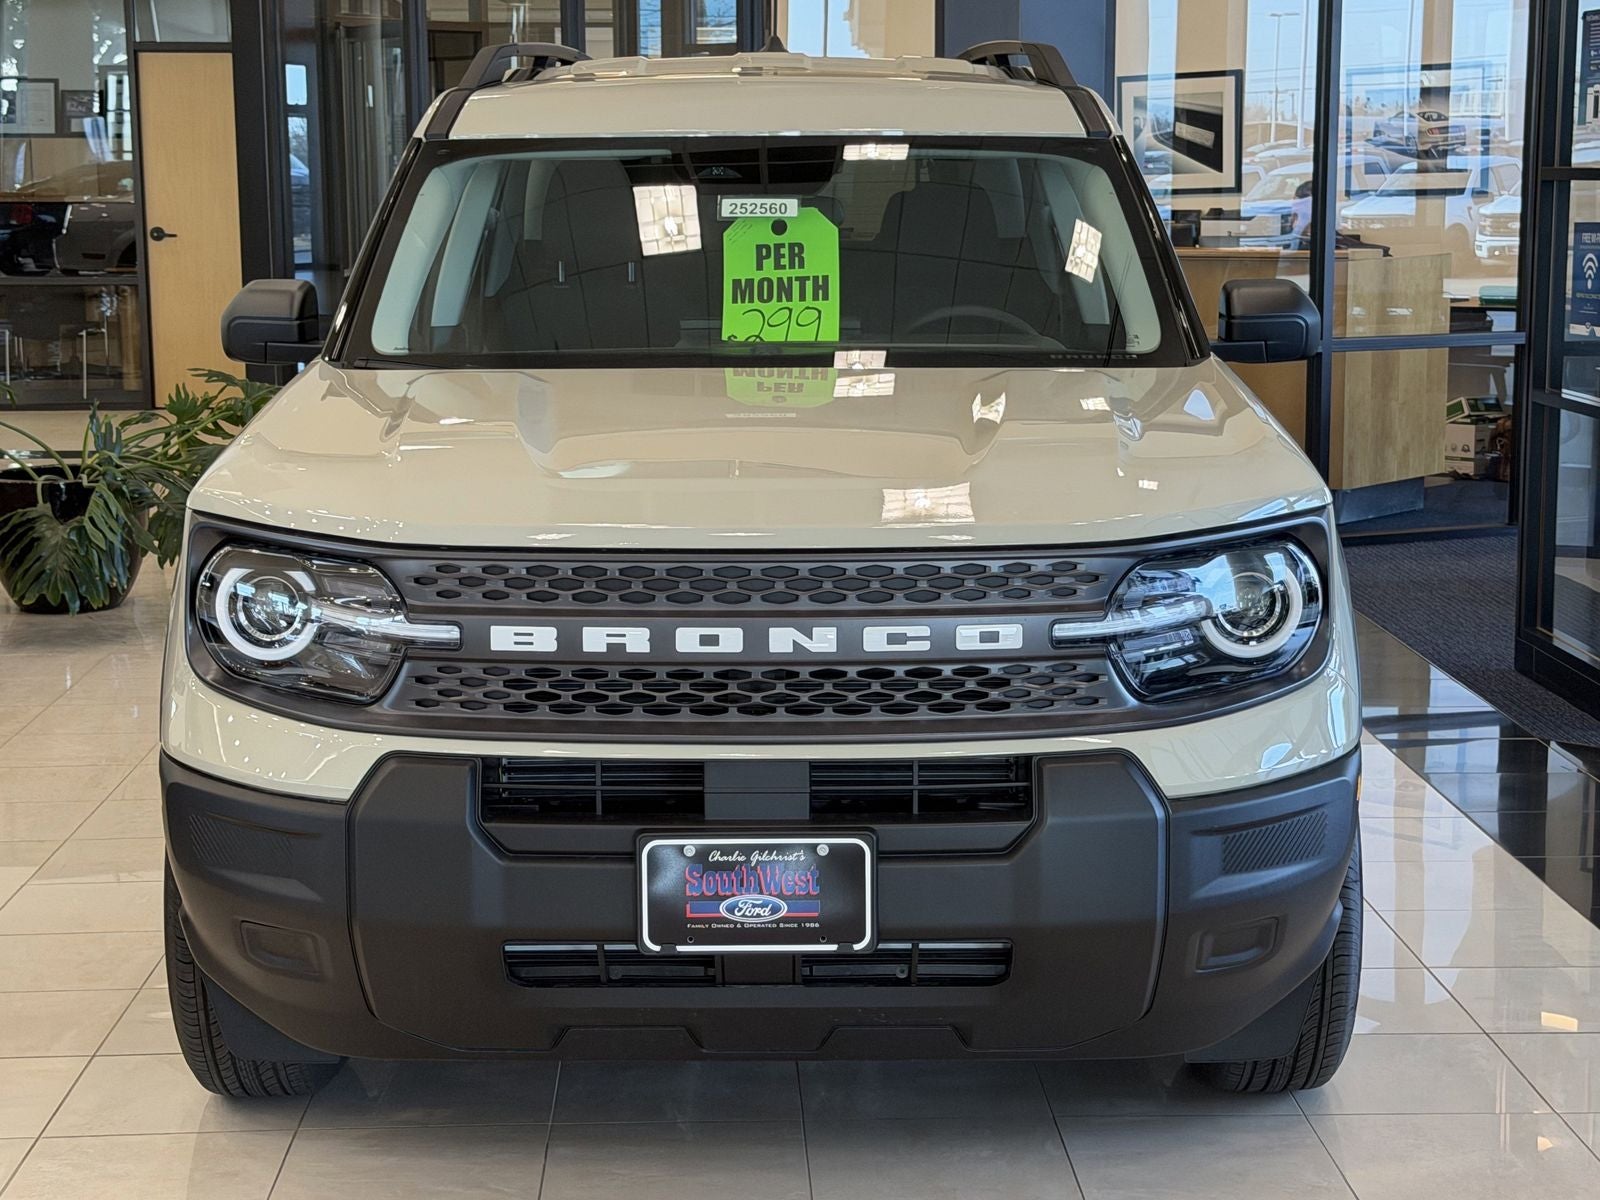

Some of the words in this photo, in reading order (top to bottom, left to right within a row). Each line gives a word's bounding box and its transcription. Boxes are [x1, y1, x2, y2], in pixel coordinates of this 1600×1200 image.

[729, 202, 788, 215] 252560
[755, 242, 805, 271] PER
[731, 275, 830, 304] MONTH
[490, 623, 1023, 653] BRONCO
[708, 850, 747, 862] Charlie
[750, 849, 807, 867] Gilchrist's
[685, 863, 821, 897] SouthWest
[734, 899, 773, 917] Ford
